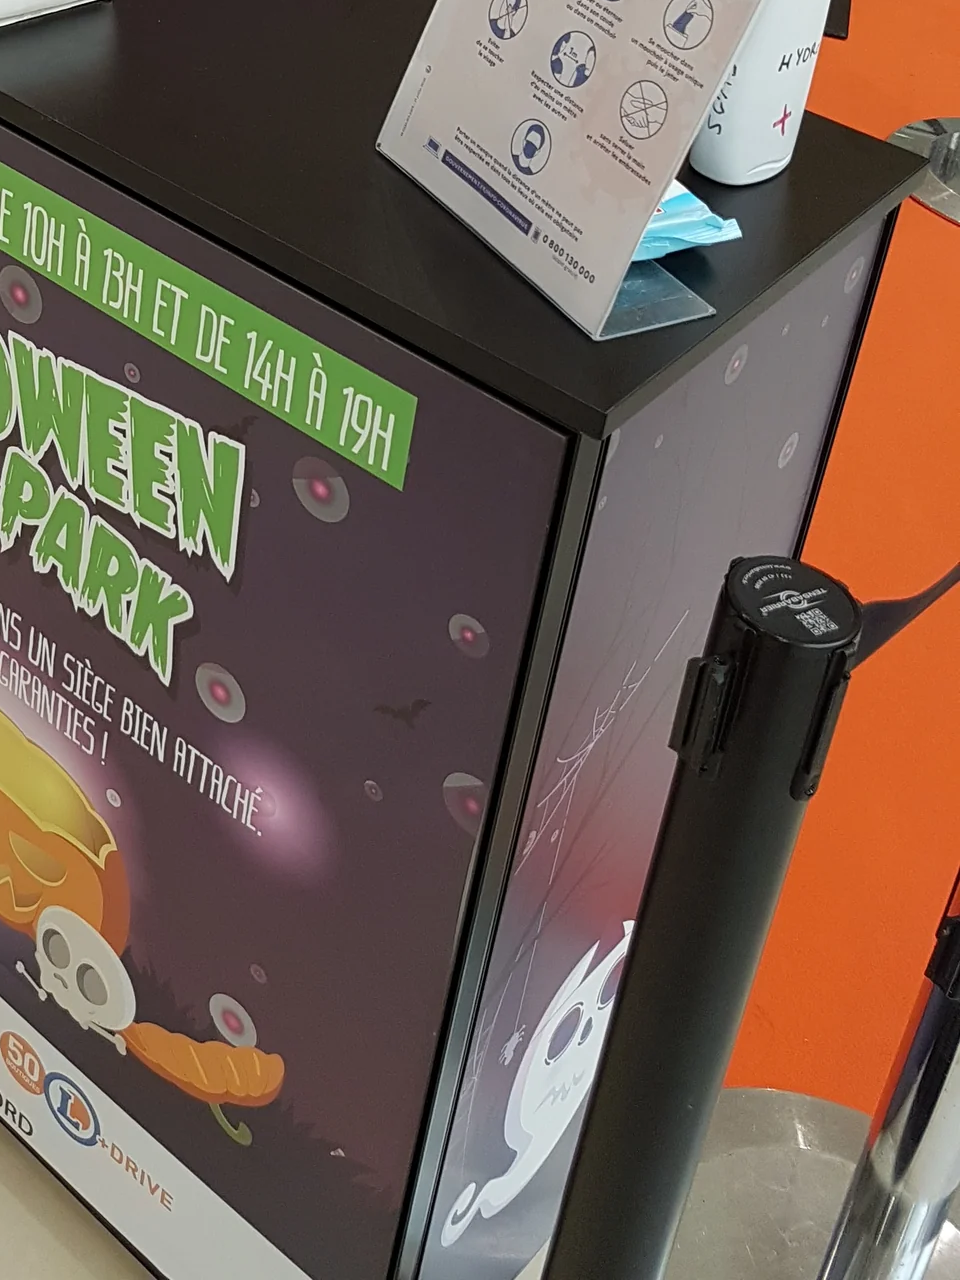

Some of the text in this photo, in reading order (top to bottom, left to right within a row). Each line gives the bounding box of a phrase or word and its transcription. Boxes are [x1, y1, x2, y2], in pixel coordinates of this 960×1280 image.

[574, 8, 586, 19] dans
[576, 0, 590, 11] dans
[590, 9, 599, 17] son
[569, 47, 578, 59] 1m
[778, 42, 820, 72] HYDR
[542, 234, 549, 244] 0
[548, 239, 565, 257] 800
[564, 253, 579, 269] 130
[578, 266, 596, 284] 000
[22, 201, 65, 277] 10H
[74, 218, 91, 291] À
[102, 247, 144, 324] 13H
[152, 277, 189, 346] ET
[195, 304, 235, 375] DE
[244, 330, 296, 413] 14H
[305, 352, 327, 431] À
[339, 386, 396, 471] 19H
[27, 625, 57, 679] UN
[61, 652, 116, 723] SIÈGE
[119, 697, 168, 763] BIEN
[6, 1033, 40, 1083] 50
